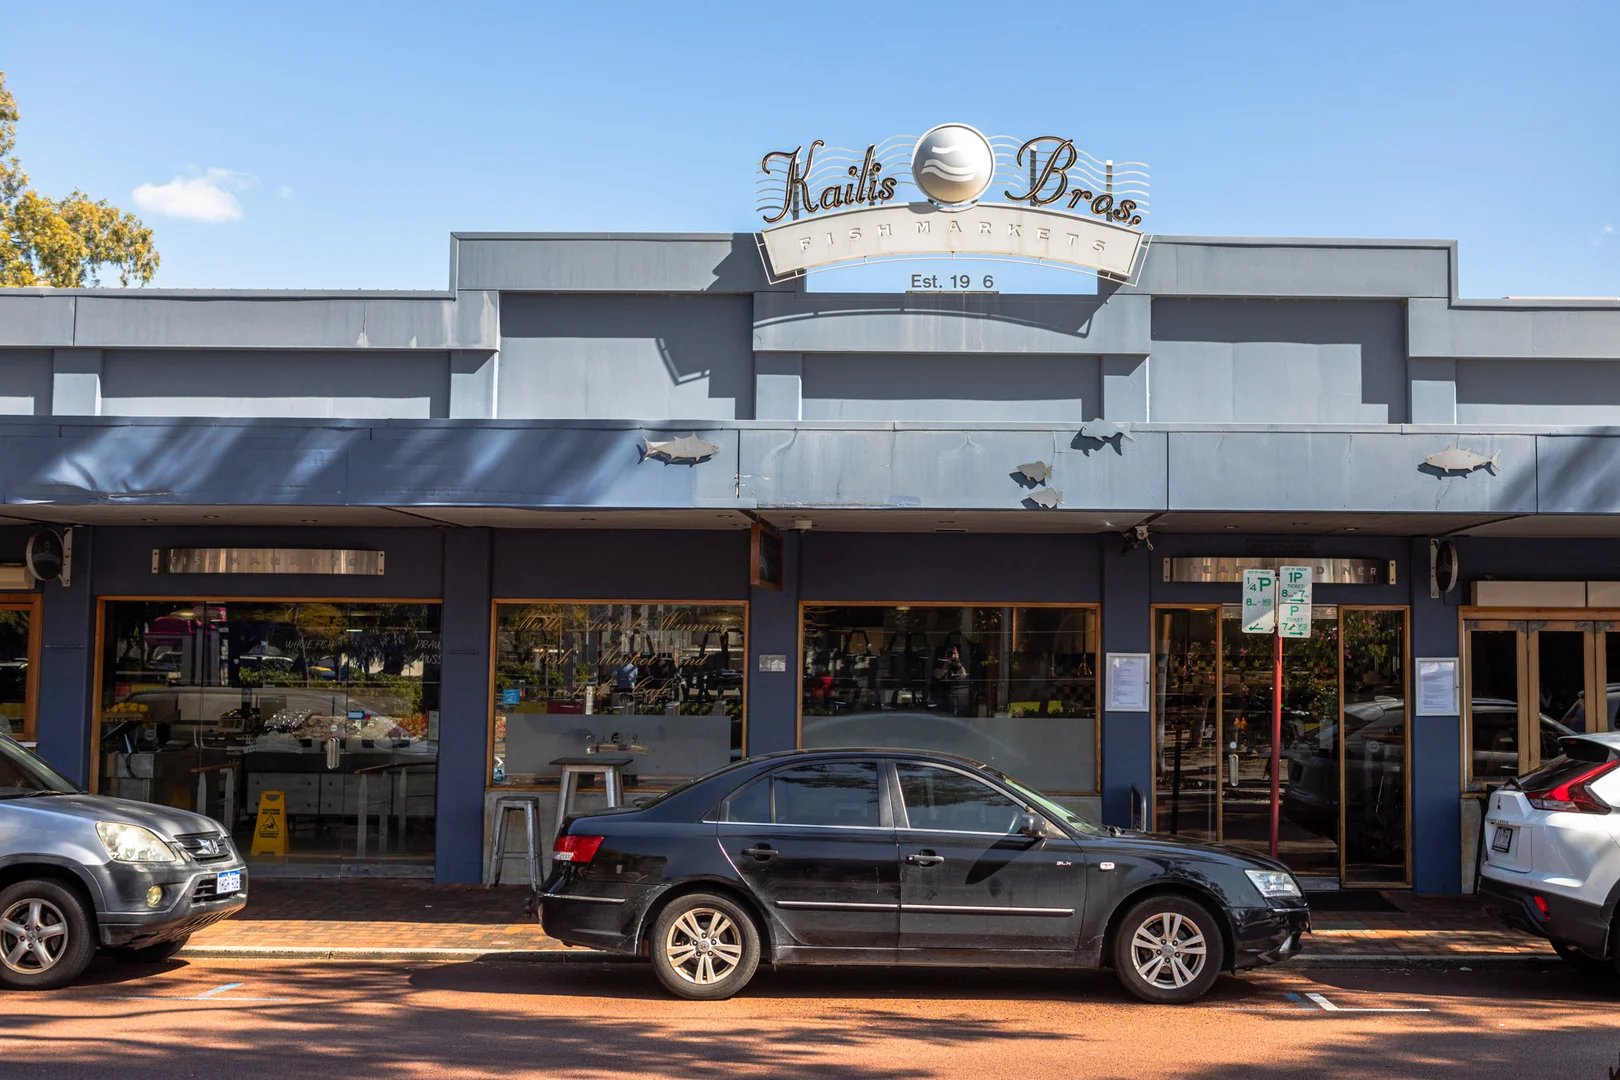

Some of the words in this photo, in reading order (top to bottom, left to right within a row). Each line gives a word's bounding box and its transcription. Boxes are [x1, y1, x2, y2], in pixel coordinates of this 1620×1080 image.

[761, 139, 898, 224] Kailis
[1004, 135, 1142, 226] Bros.
[799, 223, 892, 252] FISH
[916, 220, 1106, 253] MARKETS
[911, 274, 943, 288] Est.
[1288, 572, 1303, 583] 1P
[1290, 606, 1300, 616] P
